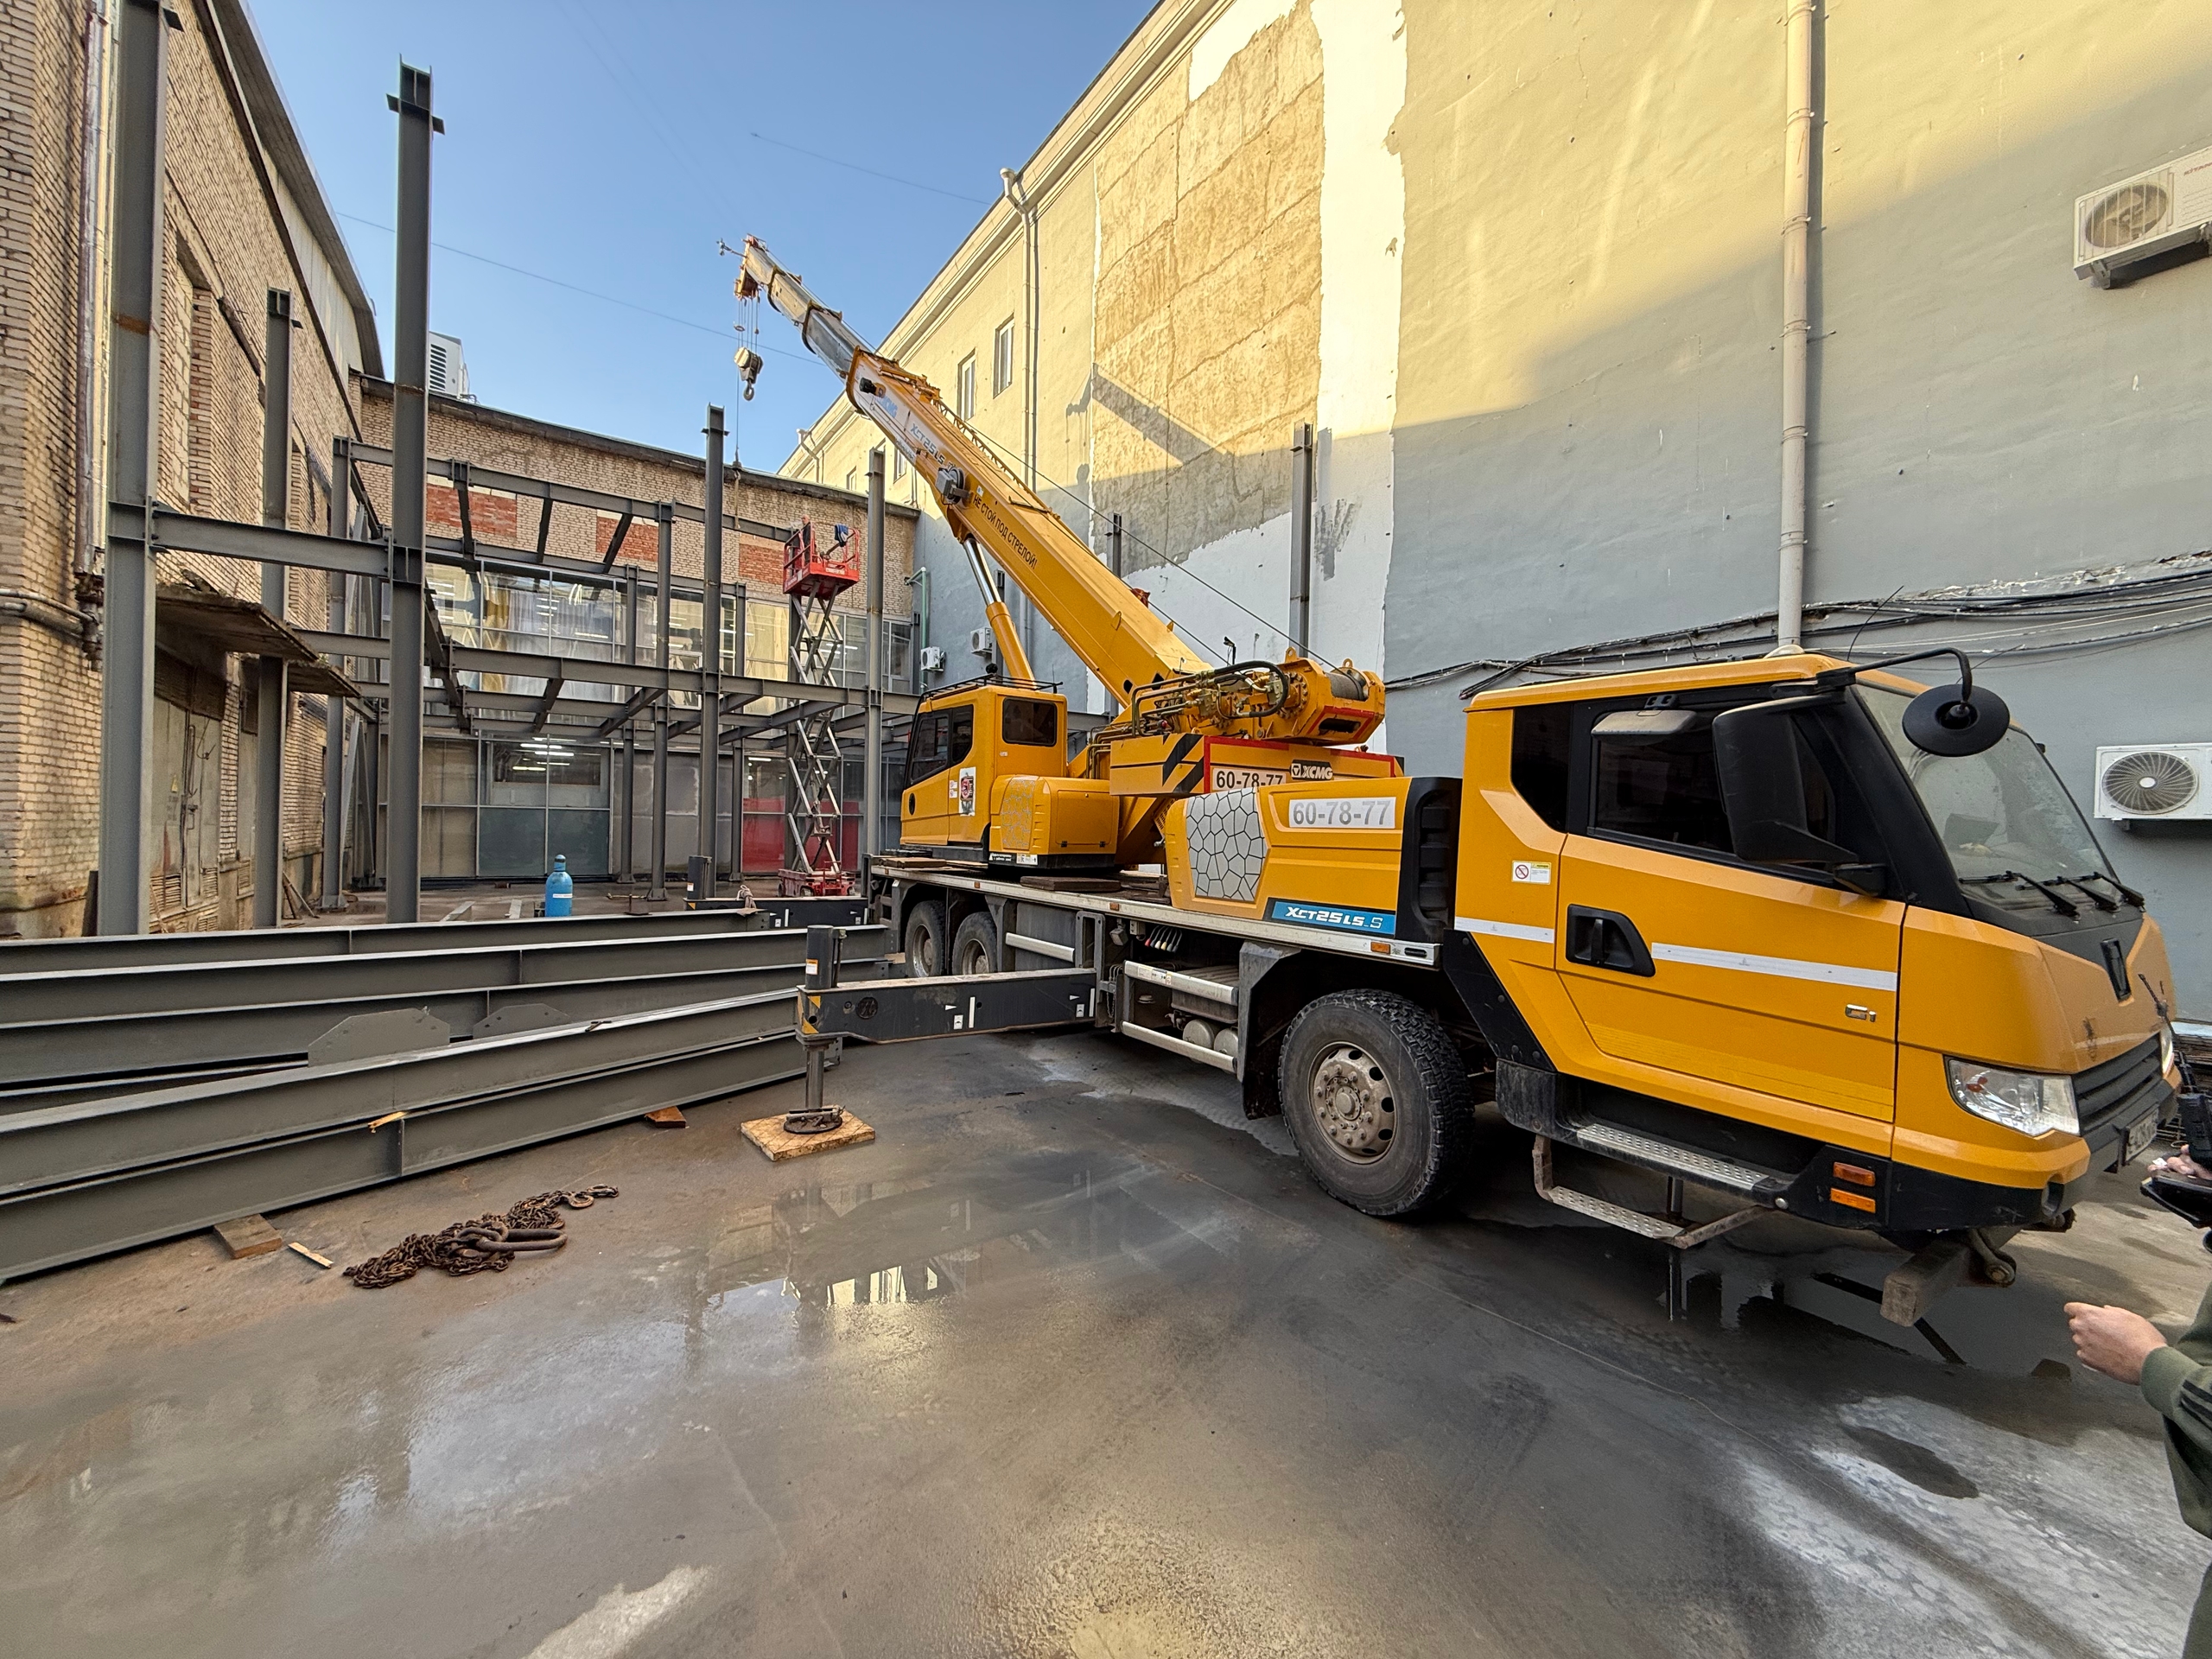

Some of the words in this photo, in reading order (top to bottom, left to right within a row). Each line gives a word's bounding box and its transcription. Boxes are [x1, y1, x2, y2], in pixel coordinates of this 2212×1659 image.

[973, 495, 982, 509] НЕ
[981, 503, 996, 524] СТОЙ
[995, 518, 1008, 540] ПОД
[1216, 770, 1283, 788] 60-78-77
[1302, 765, 1333, 779] XCMG
[1293, 800, 1391, 825] 60-78-77
